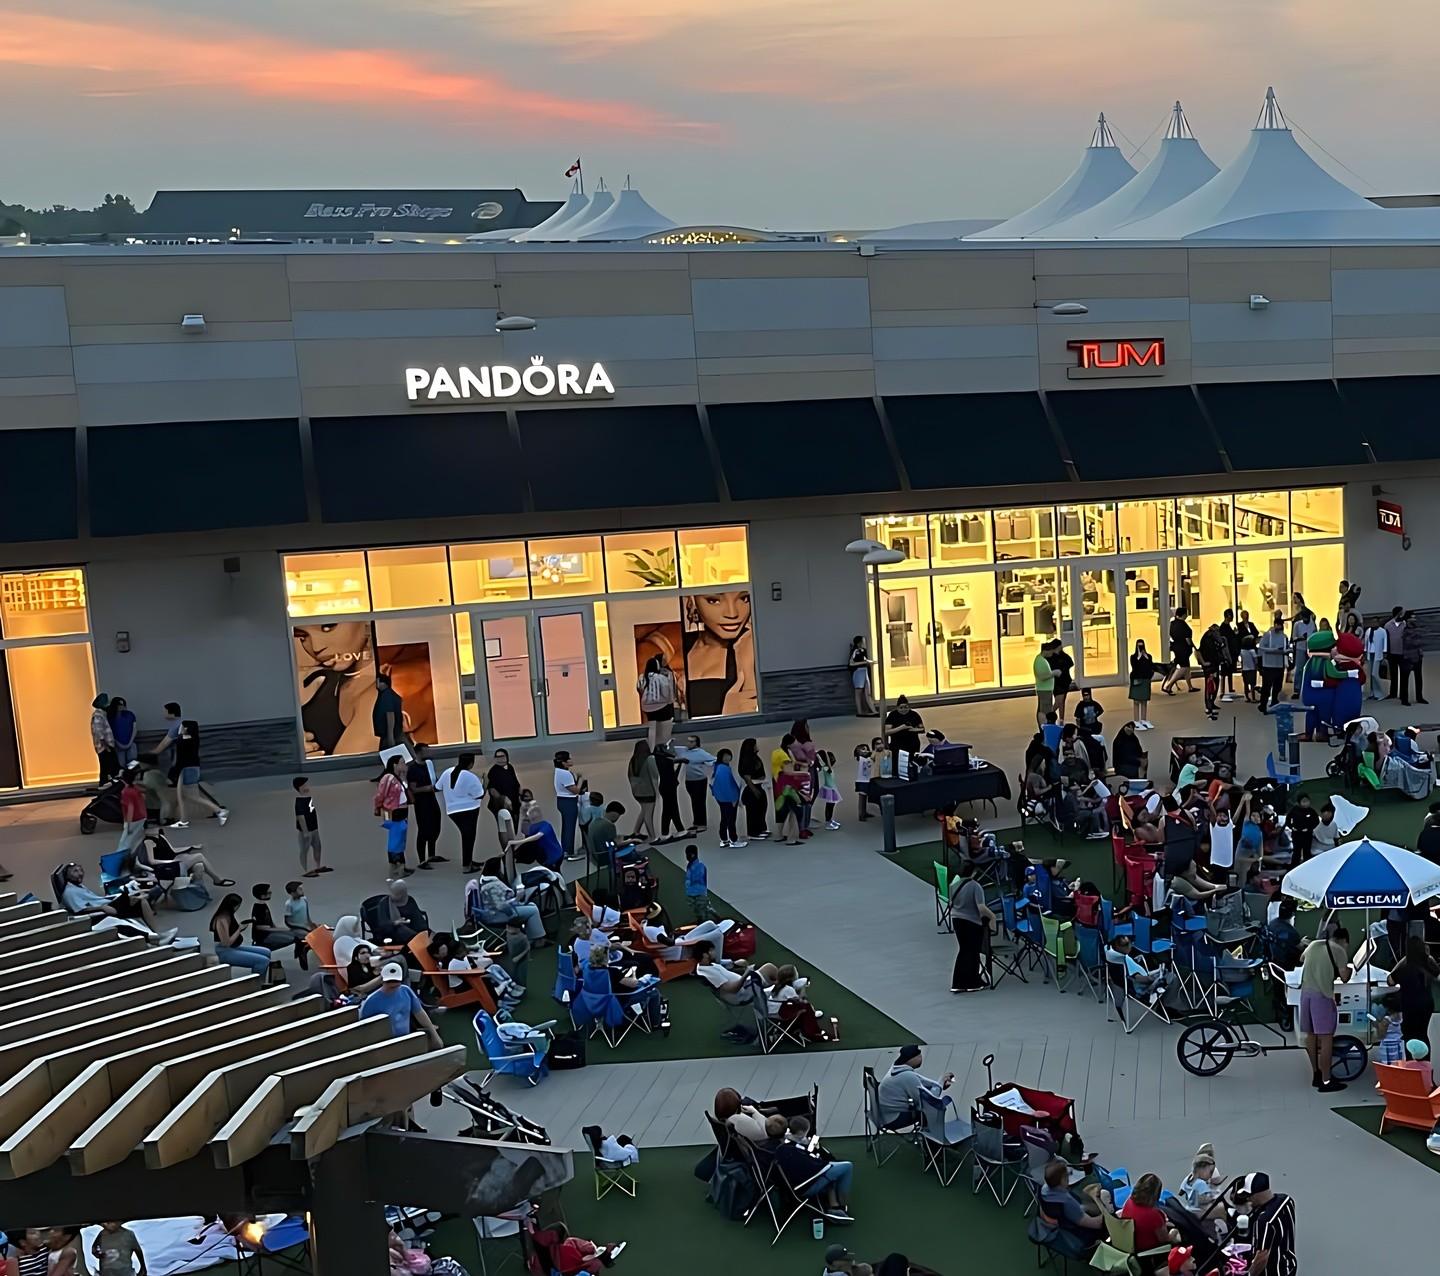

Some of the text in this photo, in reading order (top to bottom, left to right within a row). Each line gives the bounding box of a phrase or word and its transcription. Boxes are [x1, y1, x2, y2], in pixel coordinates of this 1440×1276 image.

[405, 360, 616, 400] PANDORA
[1333, 894, 1402, 906] ICE CREAM
